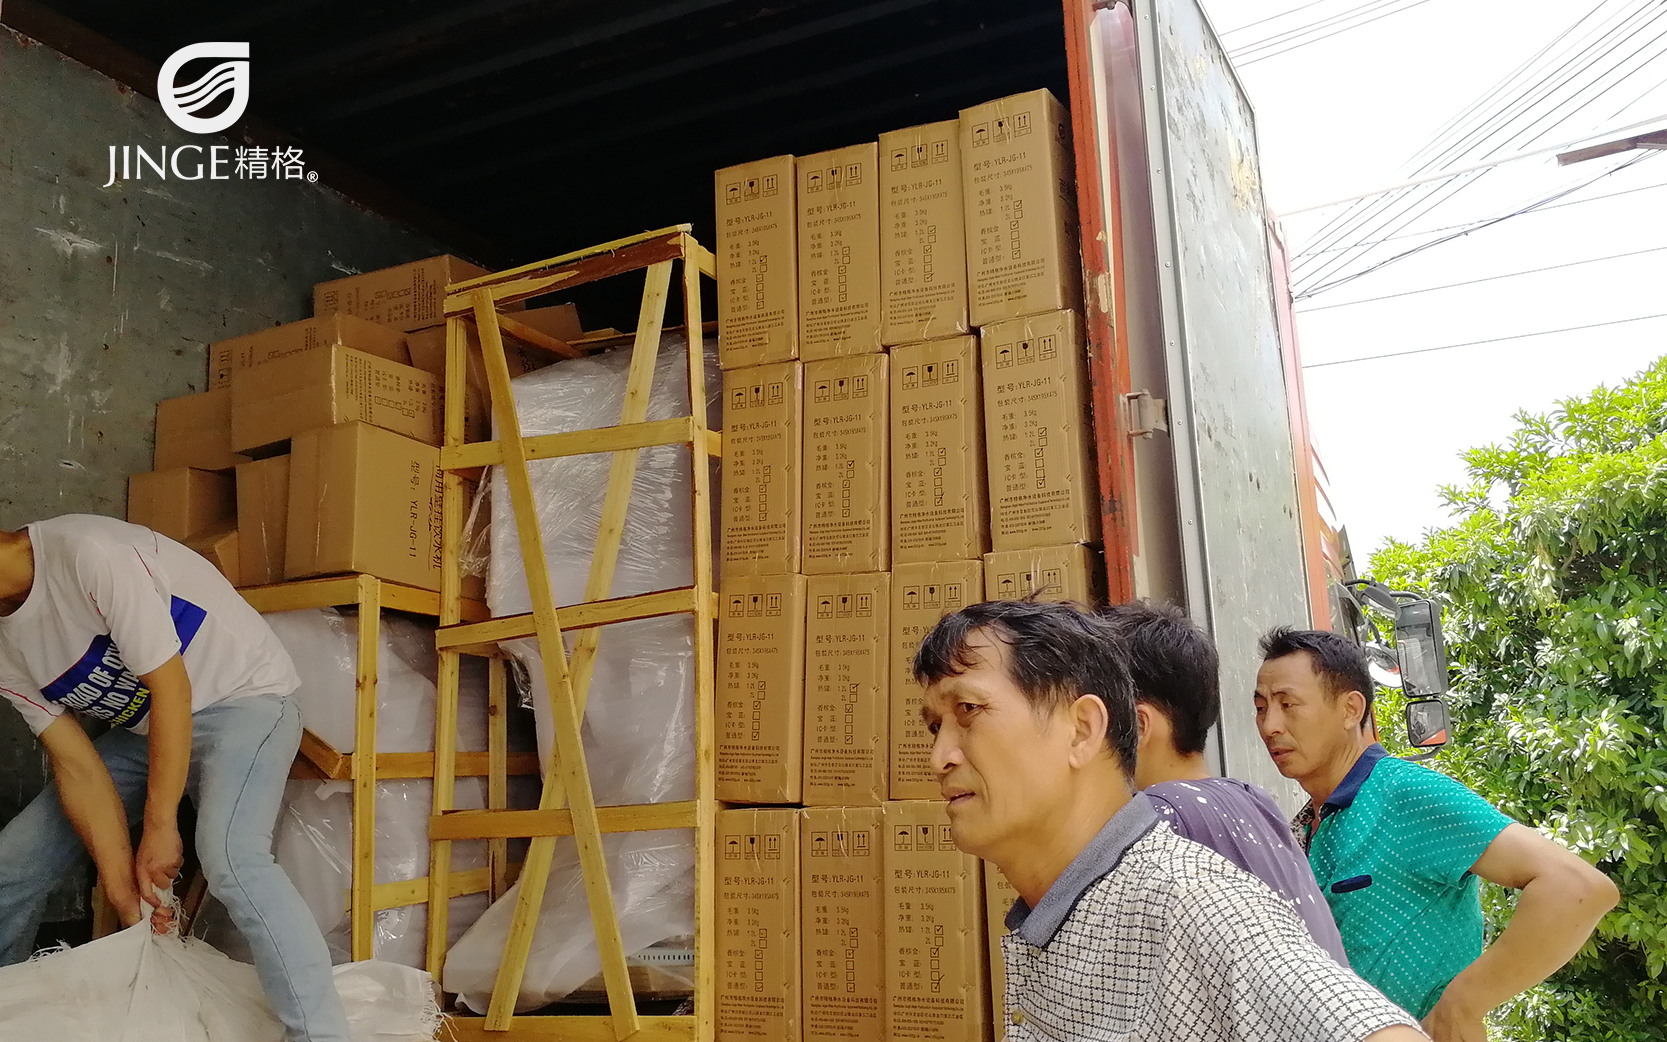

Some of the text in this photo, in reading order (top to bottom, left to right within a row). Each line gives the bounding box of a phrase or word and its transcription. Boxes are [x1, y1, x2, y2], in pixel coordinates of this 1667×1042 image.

[58, 682, 102, 709] ROAD
[88, 666, 116, 688] OF
[100, 692, 130, 710] NO
